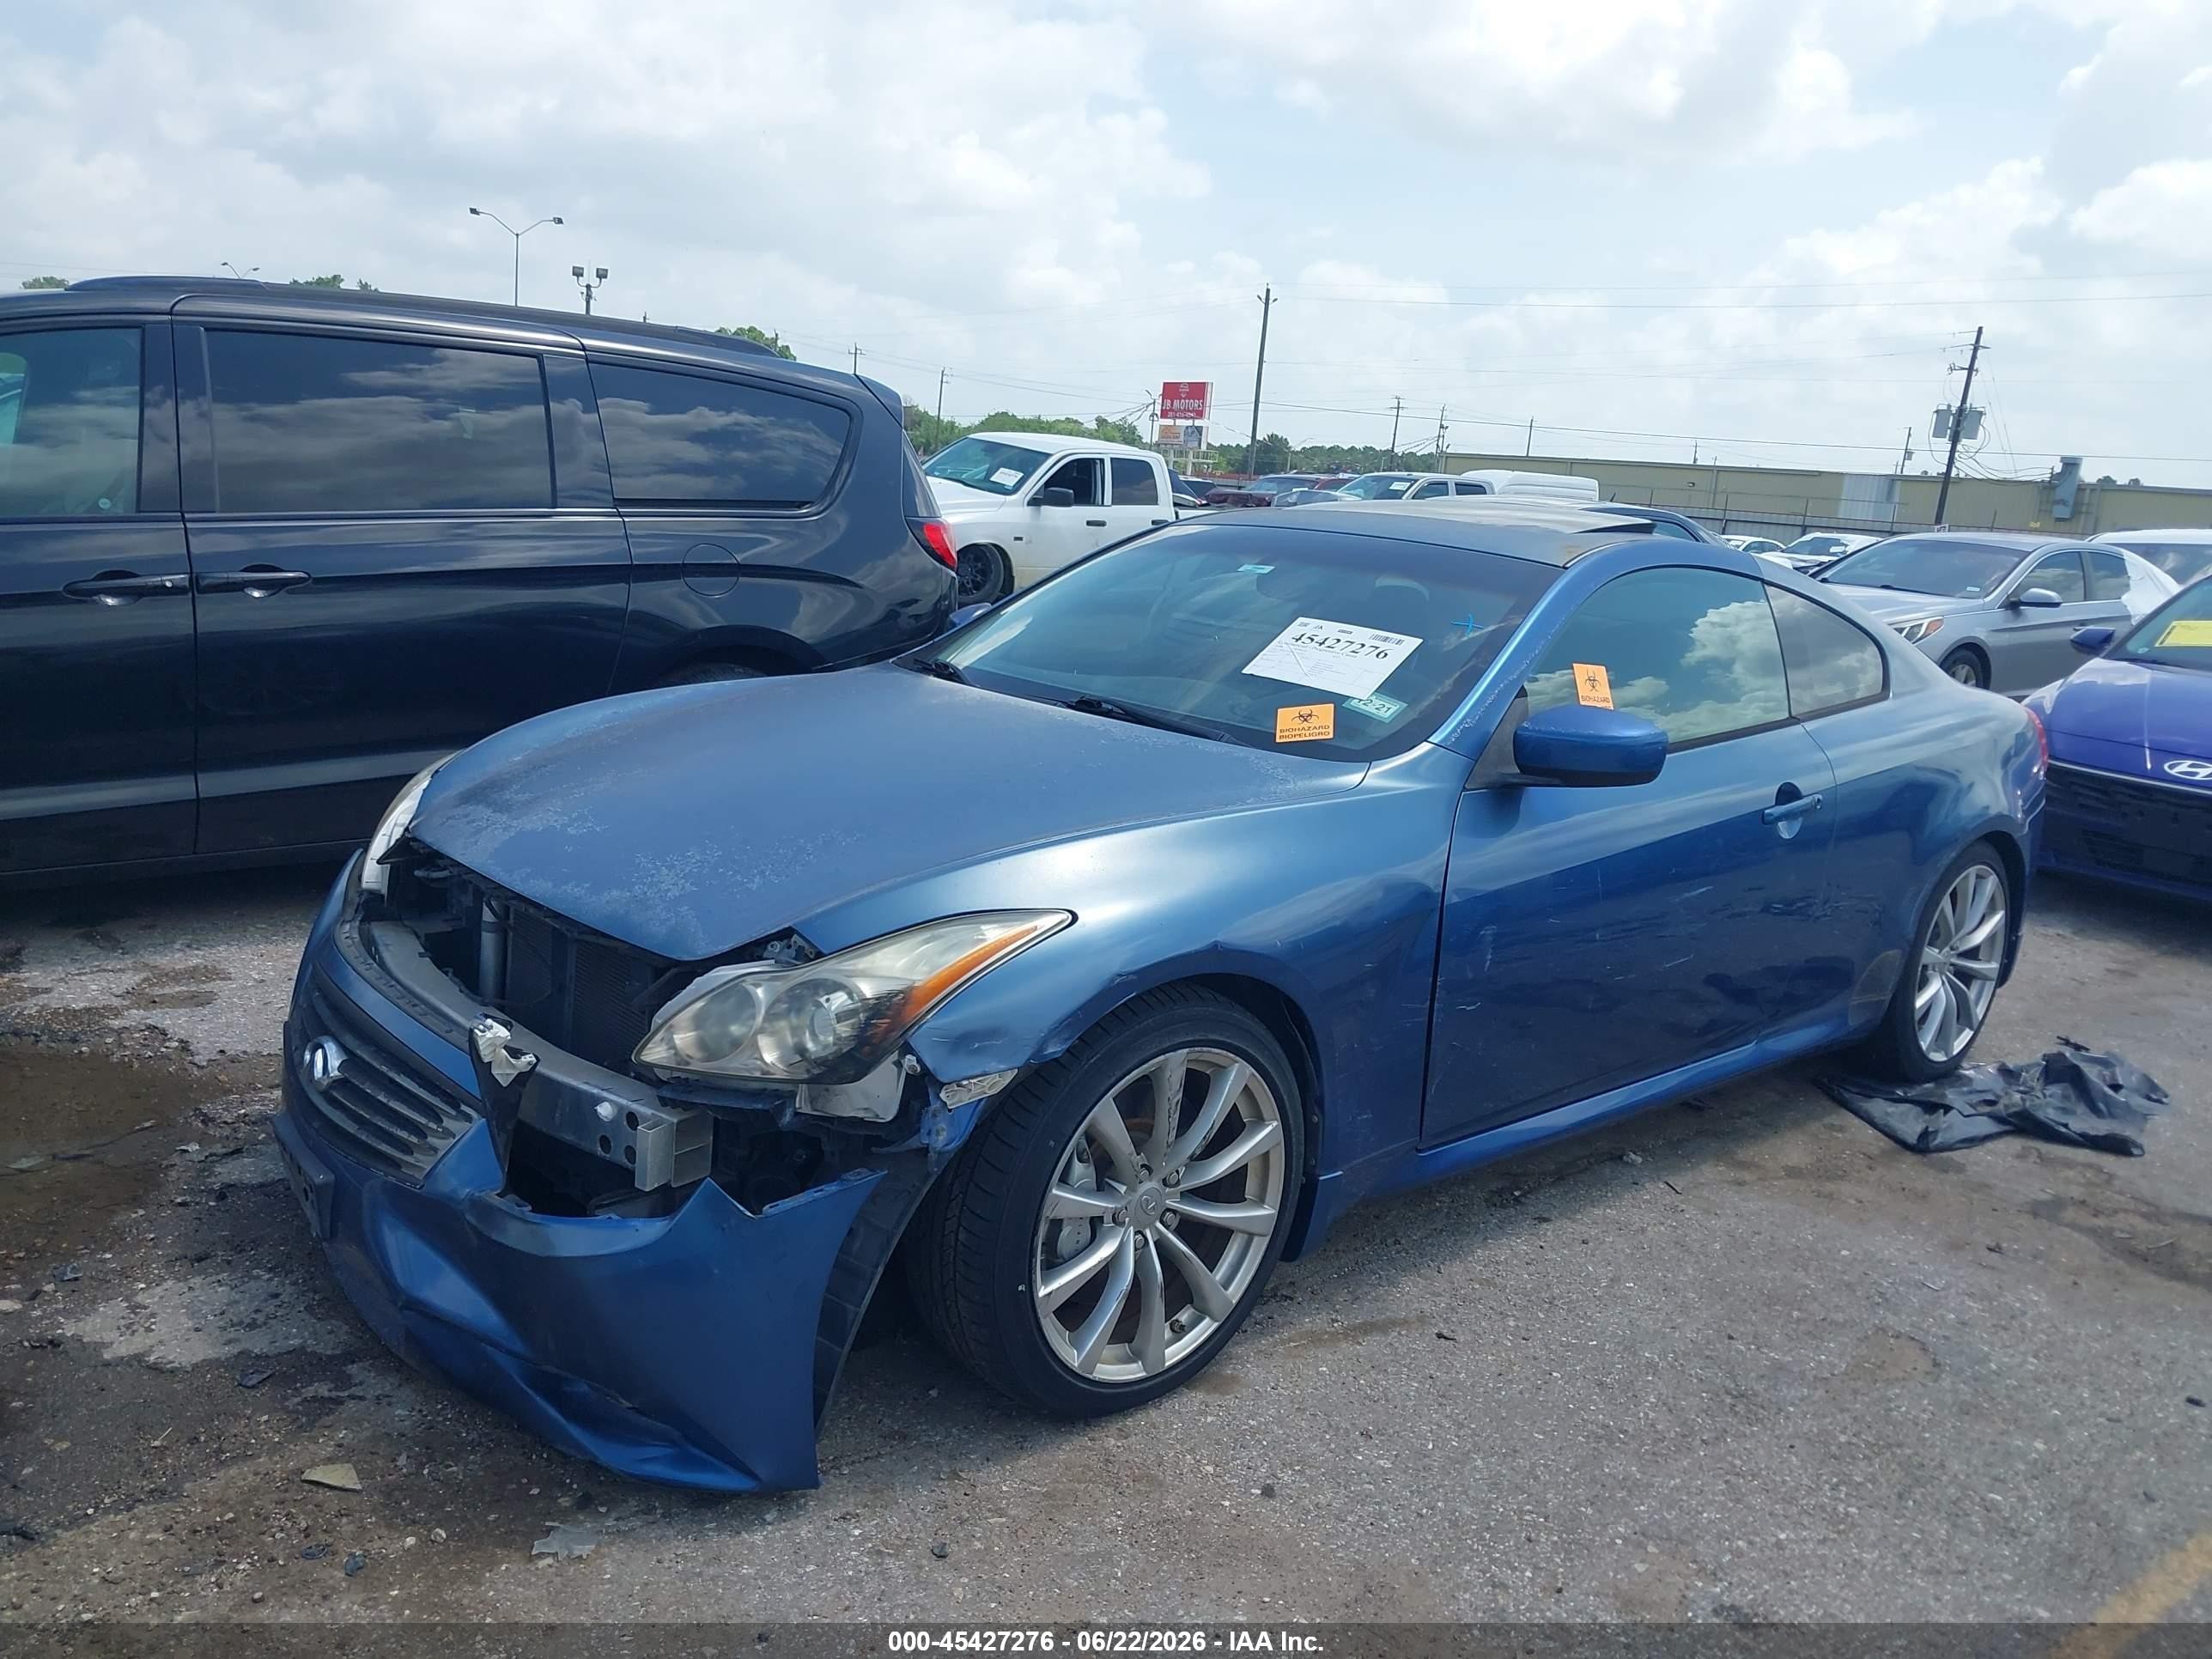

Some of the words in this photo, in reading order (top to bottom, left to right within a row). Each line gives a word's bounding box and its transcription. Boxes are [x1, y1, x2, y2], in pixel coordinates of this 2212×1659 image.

[1163, 399, 1171, 410] JB
[1173, 399, 1203, 410] MOTORS
[1291, 631, 1395, 660] 45427276
[1279, 725, 1330, 734] BIOHAZARD
[1279, 731, 1331, 740] BIOPELIGRO
